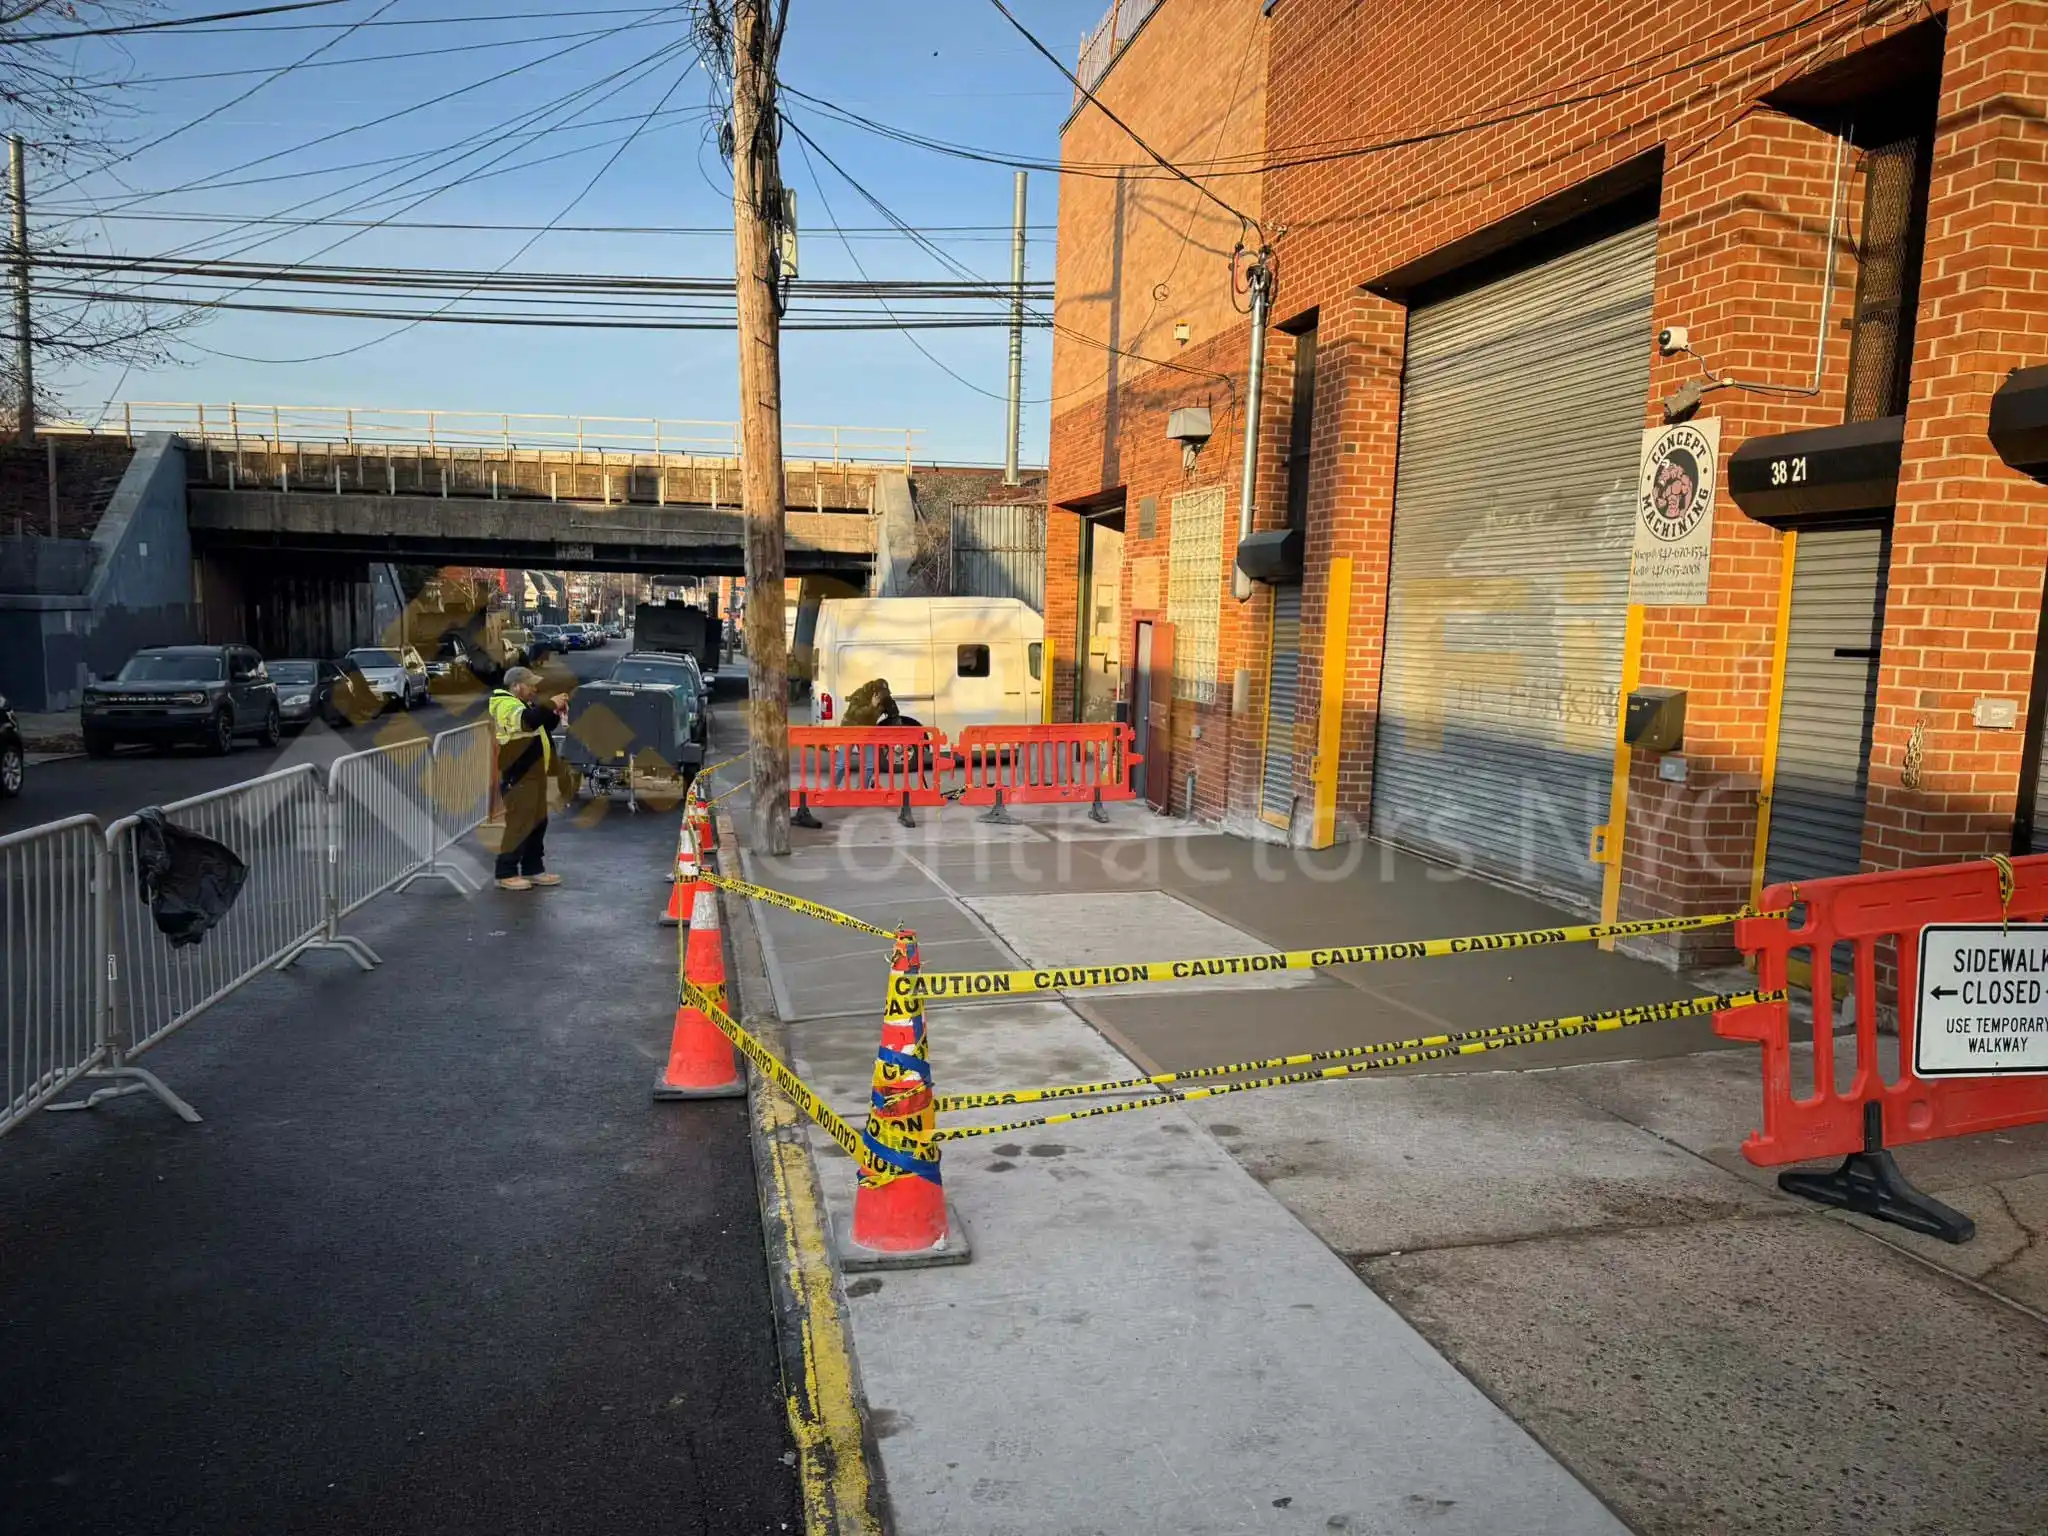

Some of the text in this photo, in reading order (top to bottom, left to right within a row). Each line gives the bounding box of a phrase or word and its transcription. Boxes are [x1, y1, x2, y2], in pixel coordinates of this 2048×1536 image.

[1652, 431, 1706, 465] CONCEPT
[1771, 456, 1806, 486] 38 21
[1642, 487, 1709, 538] MACHINING
[894, 974, 1011, 996] CAUTION
[1034, 965, 1149, 989] CAUTION
[1172, 954, 1288, 979] CAUTION
[1310, 942, 1427, 967] CAUTION
[1450, 929, 1567, 954] CAUTION
[1962, 980, 2041, 1005] CLOSED
[711, 1005, 738, 1041] CAUTION
[1946, 1017, 1971, 1034] USE
[741, 1034, 772, 1074] CAUTION
[1968, 1036, 2028, 1053] WALKWAY
[775, 1067, 811, 1112] CAUTION
[816, 1103, 856, 1154] CAUTION
